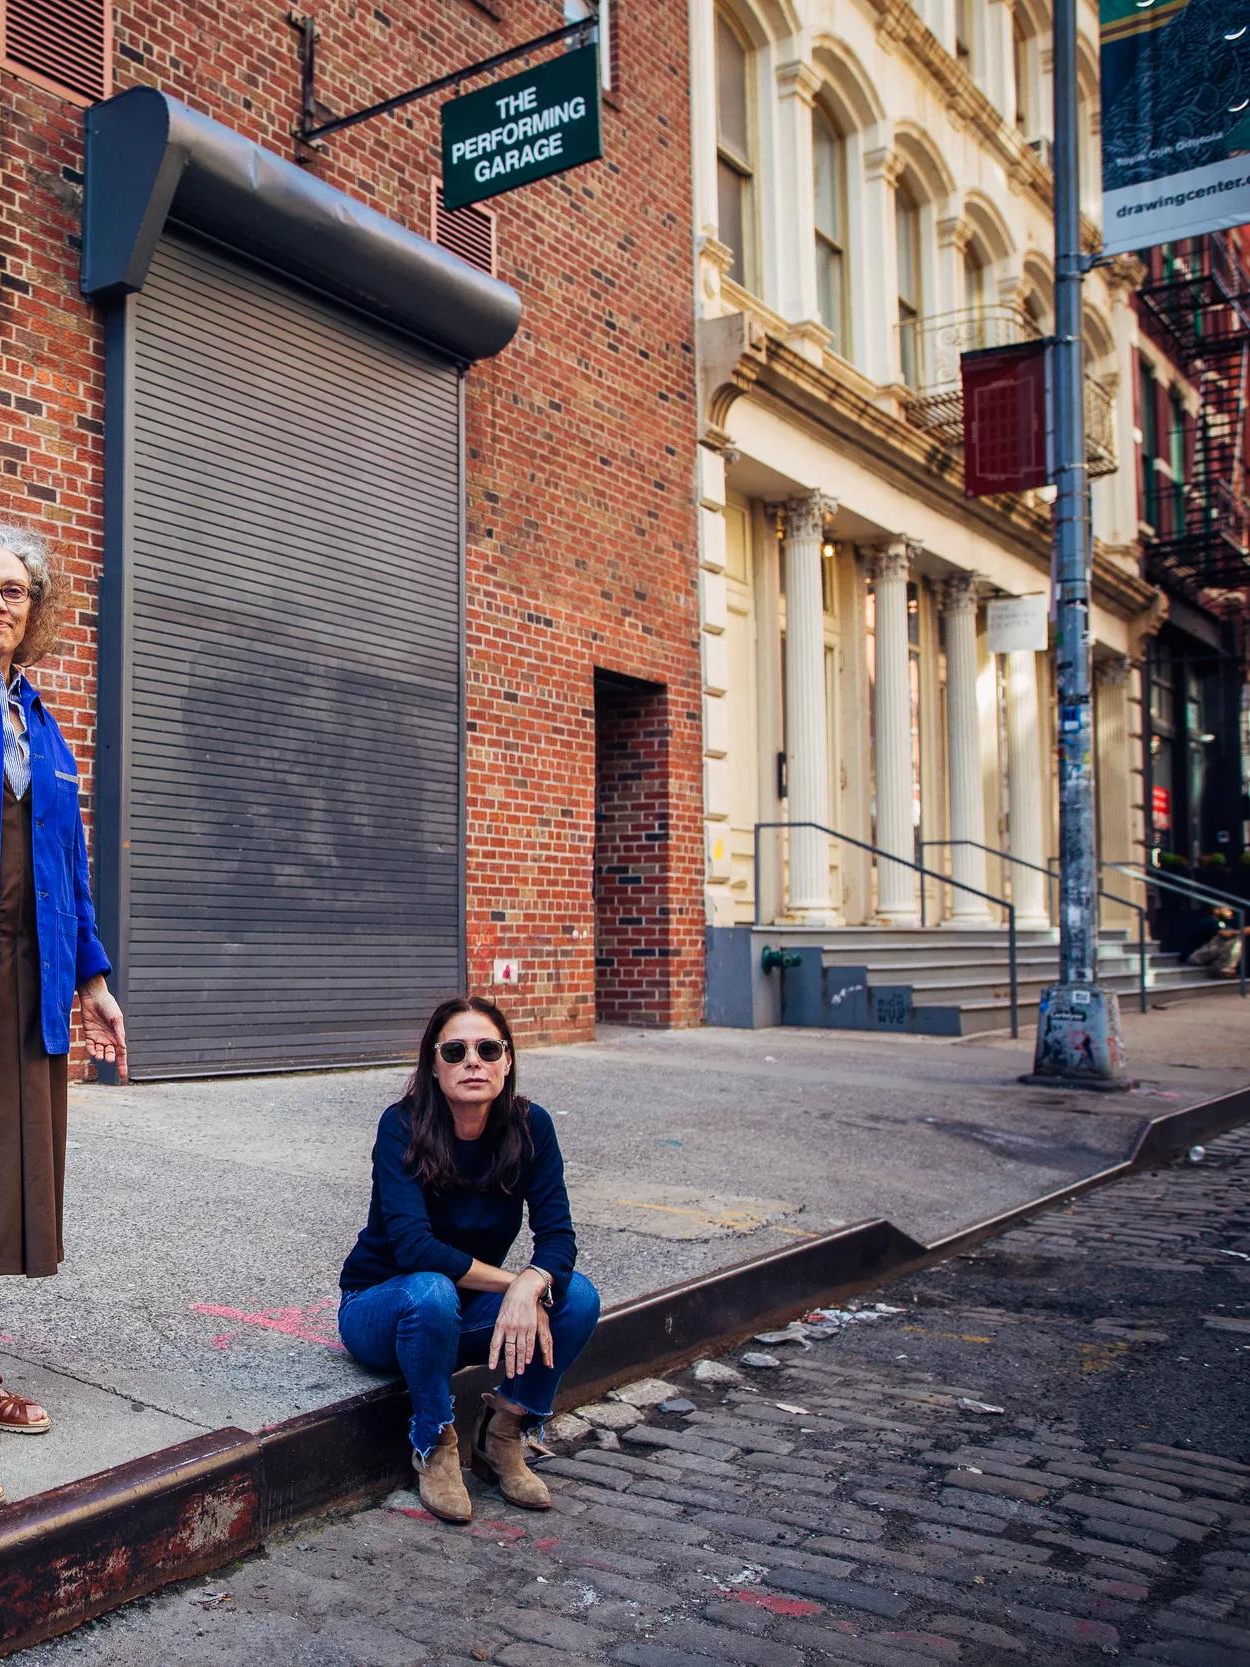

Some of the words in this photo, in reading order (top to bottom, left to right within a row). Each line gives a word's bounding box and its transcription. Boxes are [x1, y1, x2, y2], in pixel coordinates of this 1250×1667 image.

[496, 86, 538, 120] THE
[451, 96, 587, 165] PERFORMING
[474, 132, 564, 183] GARAGE
